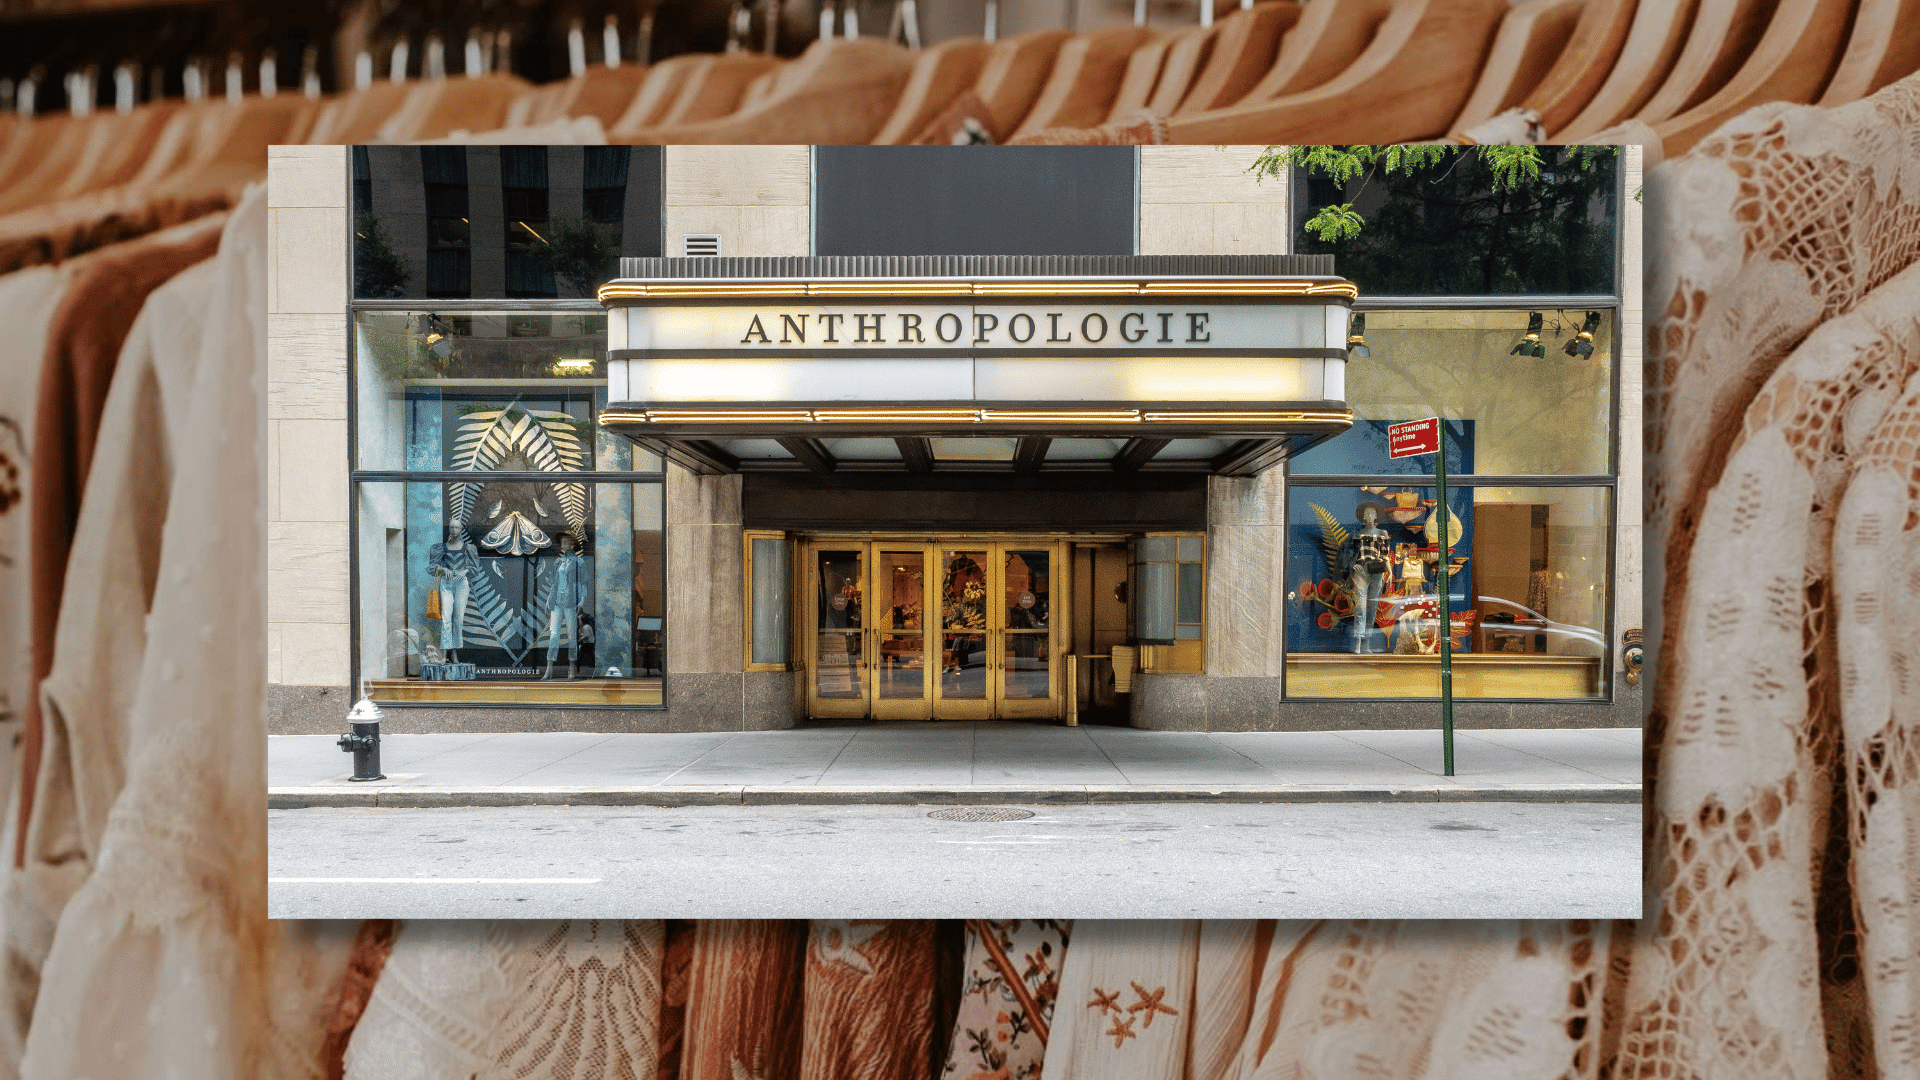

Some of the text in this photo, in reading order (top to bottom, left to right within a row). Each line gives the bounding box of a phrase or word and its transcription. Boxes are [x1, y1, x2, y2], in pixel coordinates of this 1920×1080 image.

[740, 312, 1211, 343] ANTHROPOLOGIE
[1391, 422, 1430, 435] NO STANDING
